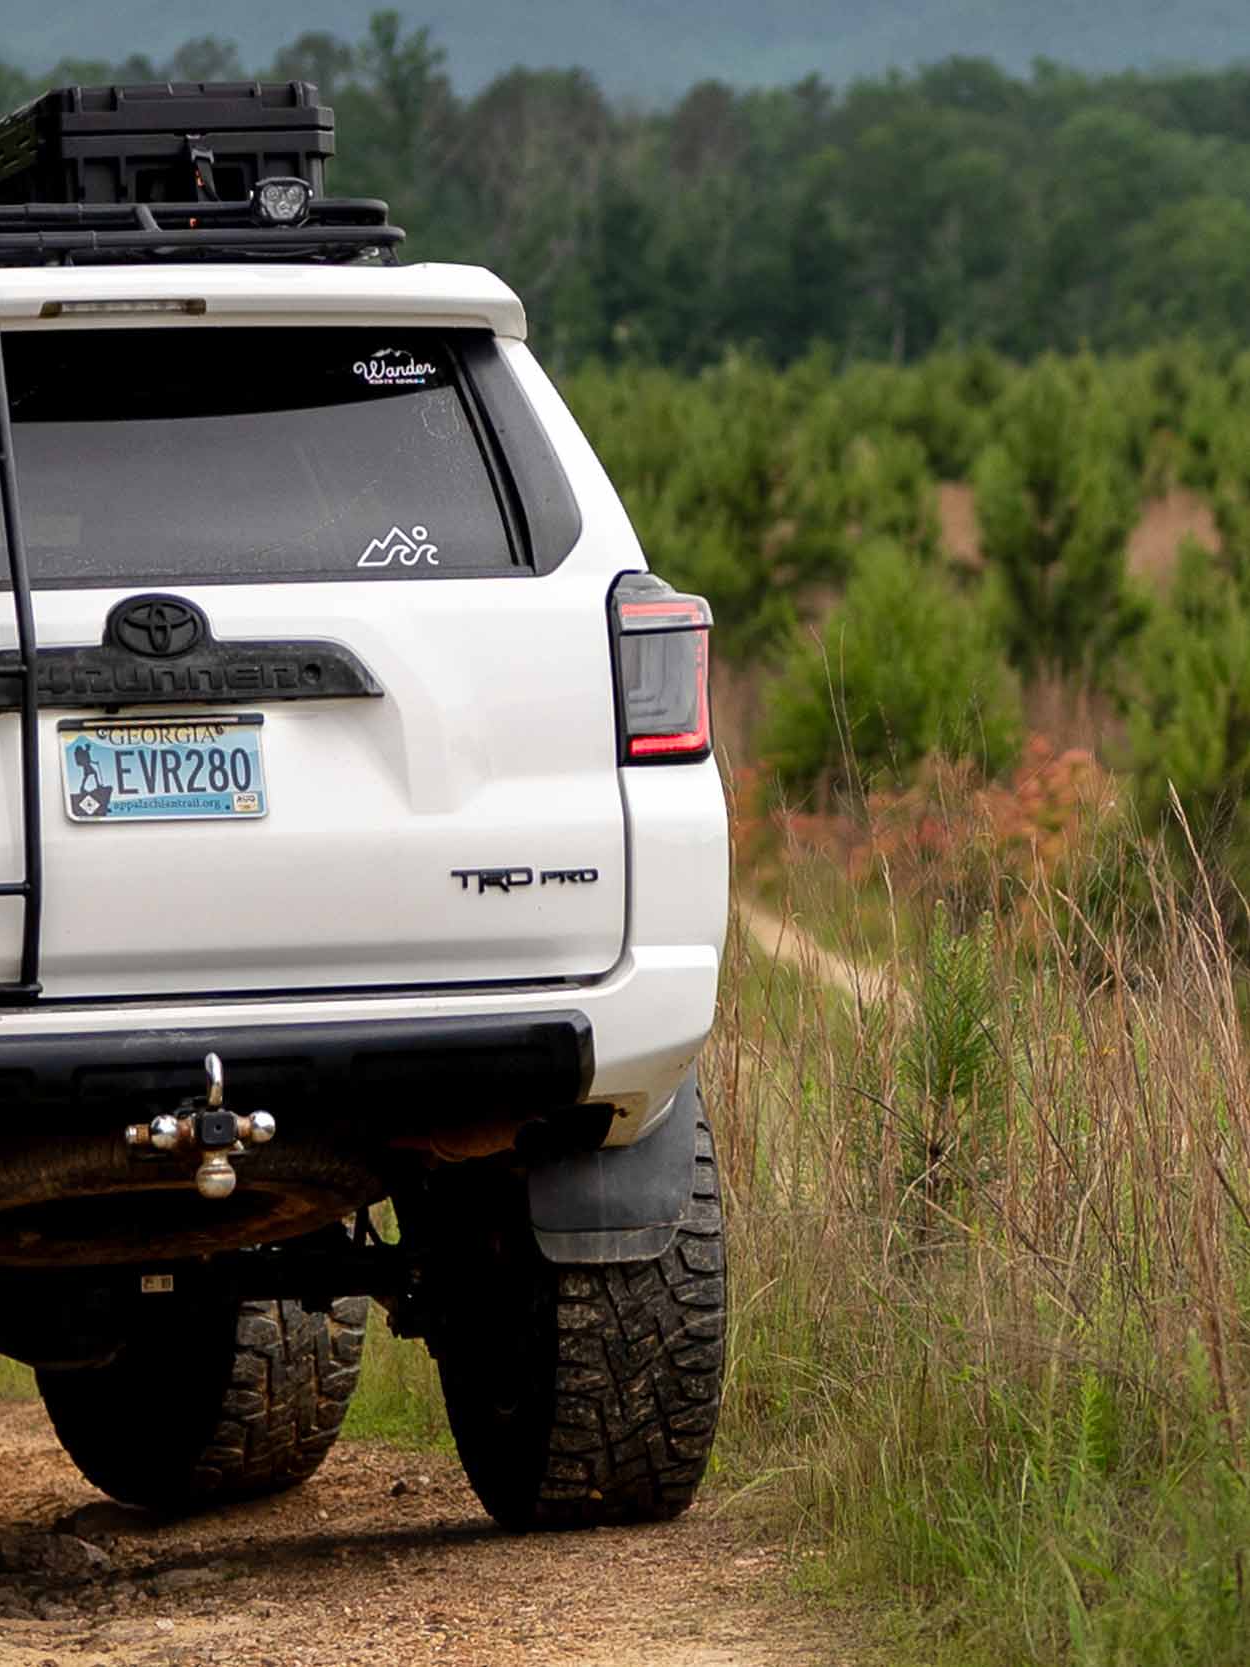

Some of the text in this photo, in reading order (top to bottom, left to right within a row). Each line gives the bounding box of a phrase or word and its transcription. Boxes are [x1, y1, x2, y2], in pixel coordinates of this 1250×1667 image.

[353, 357, 436, 380] Wander
[109, 726, 216, 745] GEORGIA
[114, 747, 251, 795] EVR280
[450, 867, 599, 895] TRD PRO
